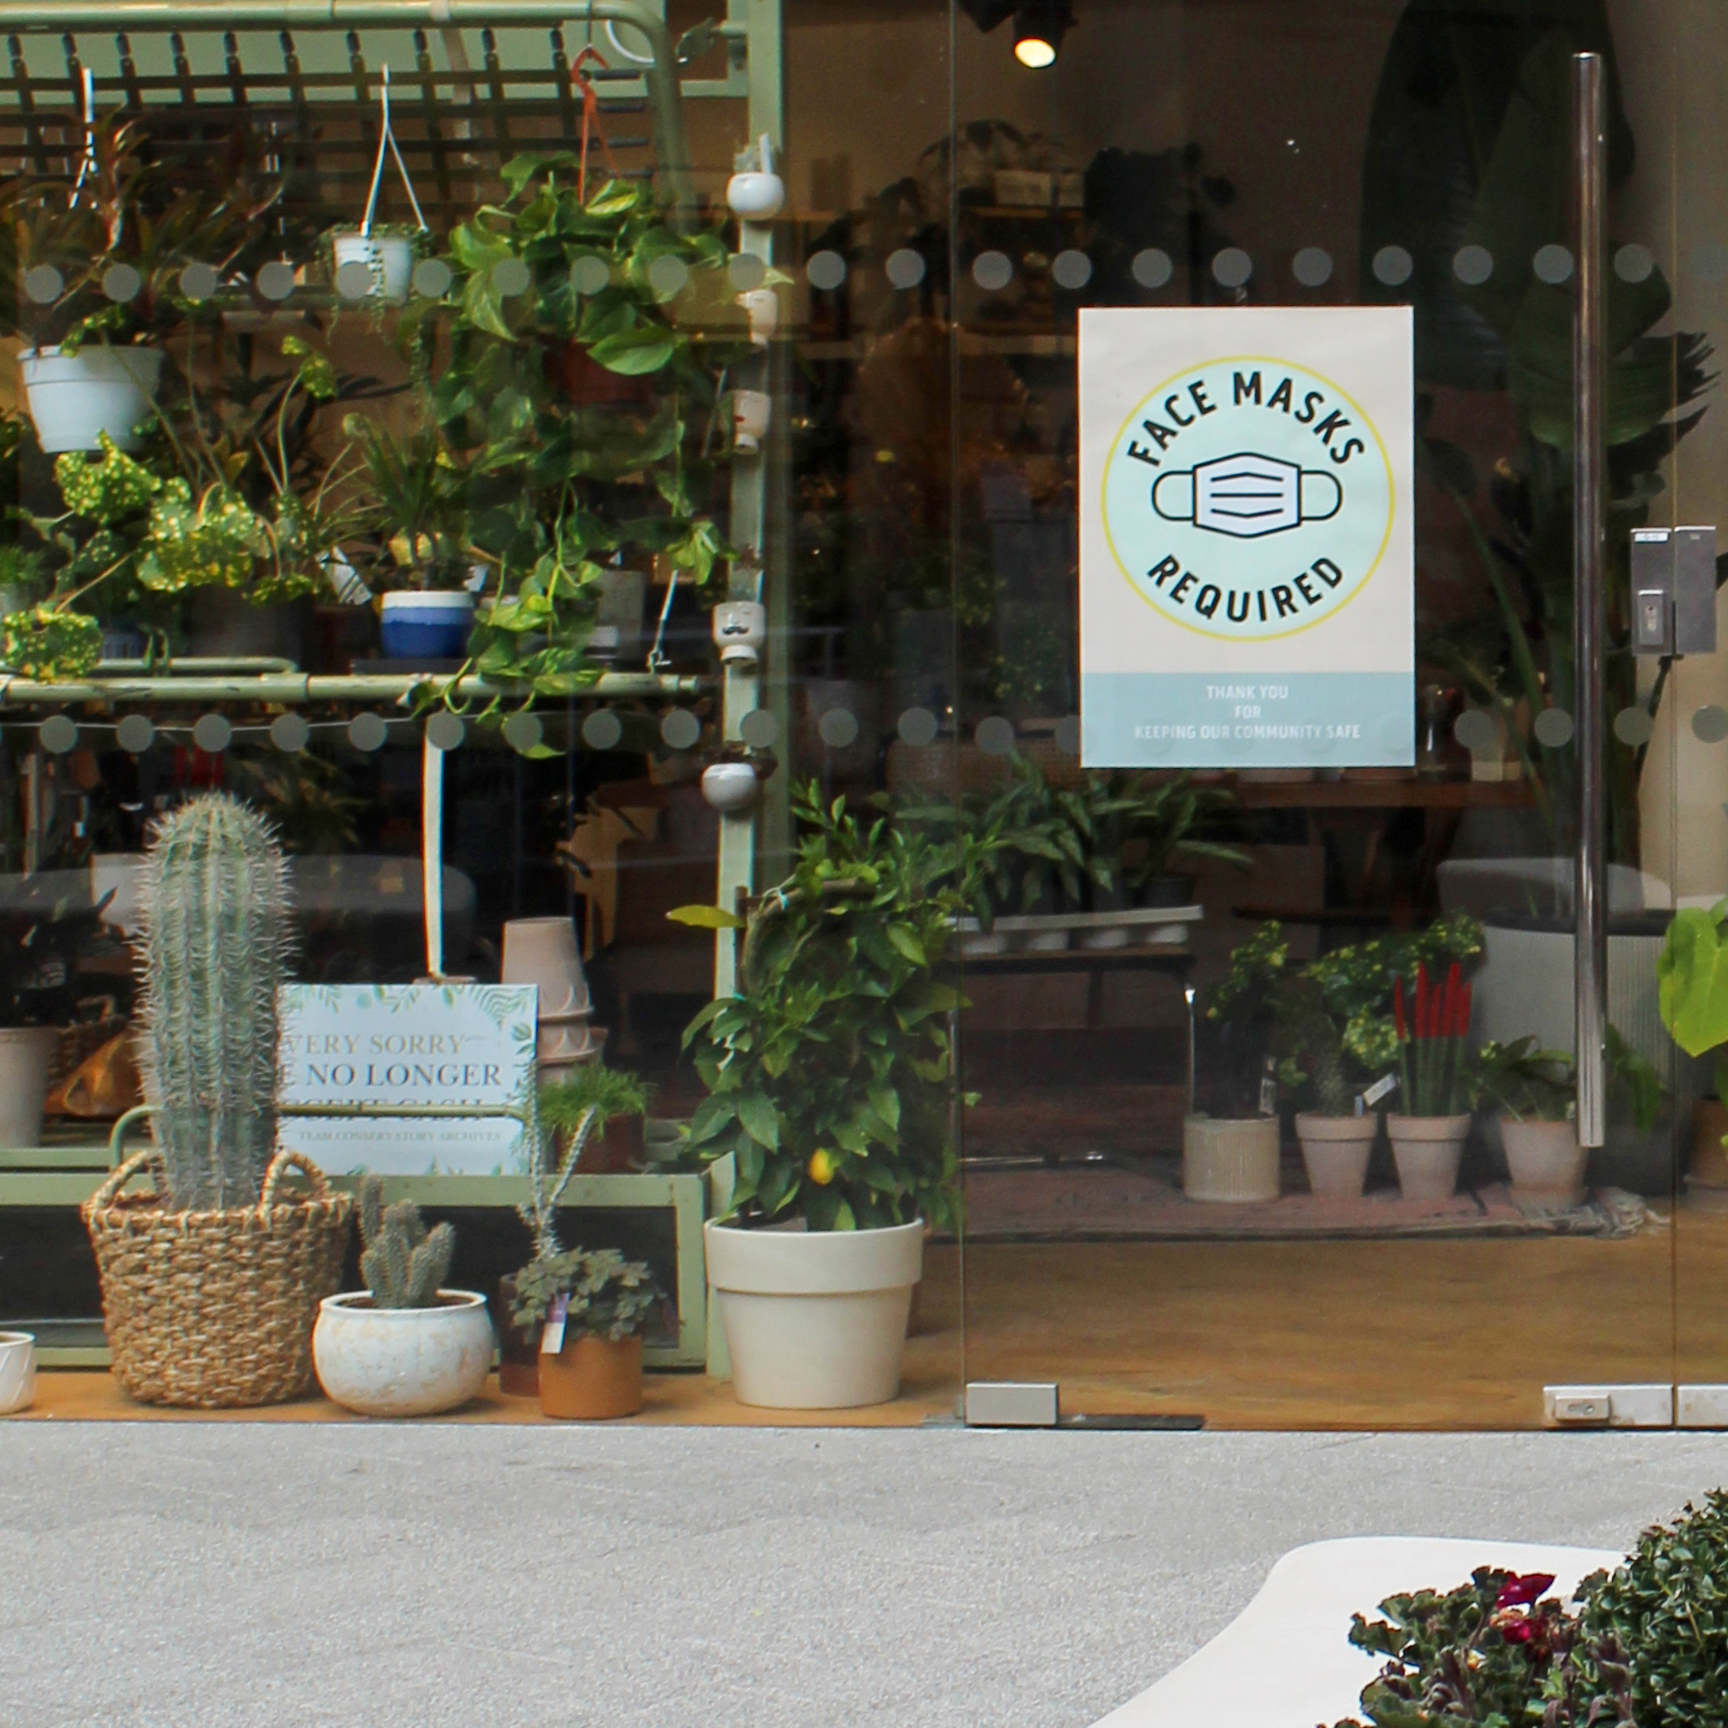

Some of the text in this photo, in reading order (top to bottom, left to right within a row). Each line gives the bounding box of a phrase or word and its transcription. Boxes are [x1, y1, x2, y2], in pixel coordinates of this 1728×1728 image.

[1127, 371, 1366, 467] FACE MASKS
[1146, 553, 1345, 624] REQUIRED
[1206, 685, 1289, 699] THANK YOU
[1234, 705, 1262, 719] FOR
[1134, 725, 1361, 739] KEEPING OUR COMMUNITY SAFE
[370, 1034, 464, 1054] SORRY
[306, 1063, 356, 1087] NO
[365, 1063, 501, 1087] LONGER
